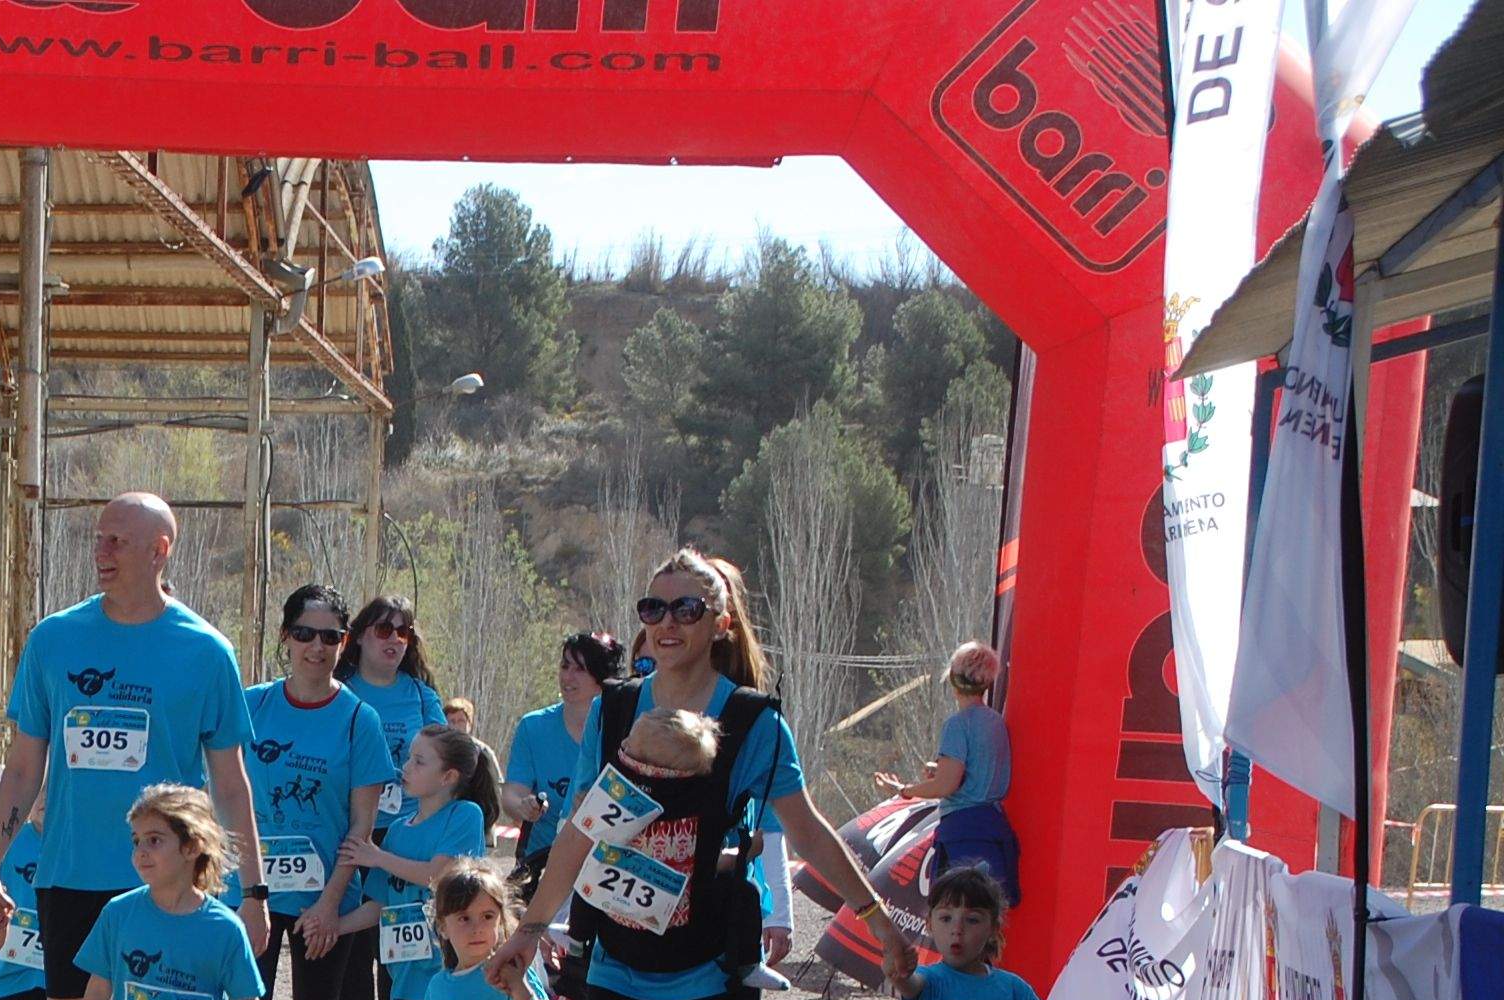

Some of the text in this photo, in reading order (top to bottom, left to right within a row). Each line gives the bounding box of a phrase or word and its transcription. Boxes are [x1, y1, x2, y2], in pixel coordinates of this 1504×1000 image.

[1186, 26, 1244, 125] DE
[971, 36, 1167, 240] barri
[80, 729, 128, 750] 305
[262, 856, 307, 874] 759
[598, 868, 656, 908] 213
[392, 924, 424, 943] 760
